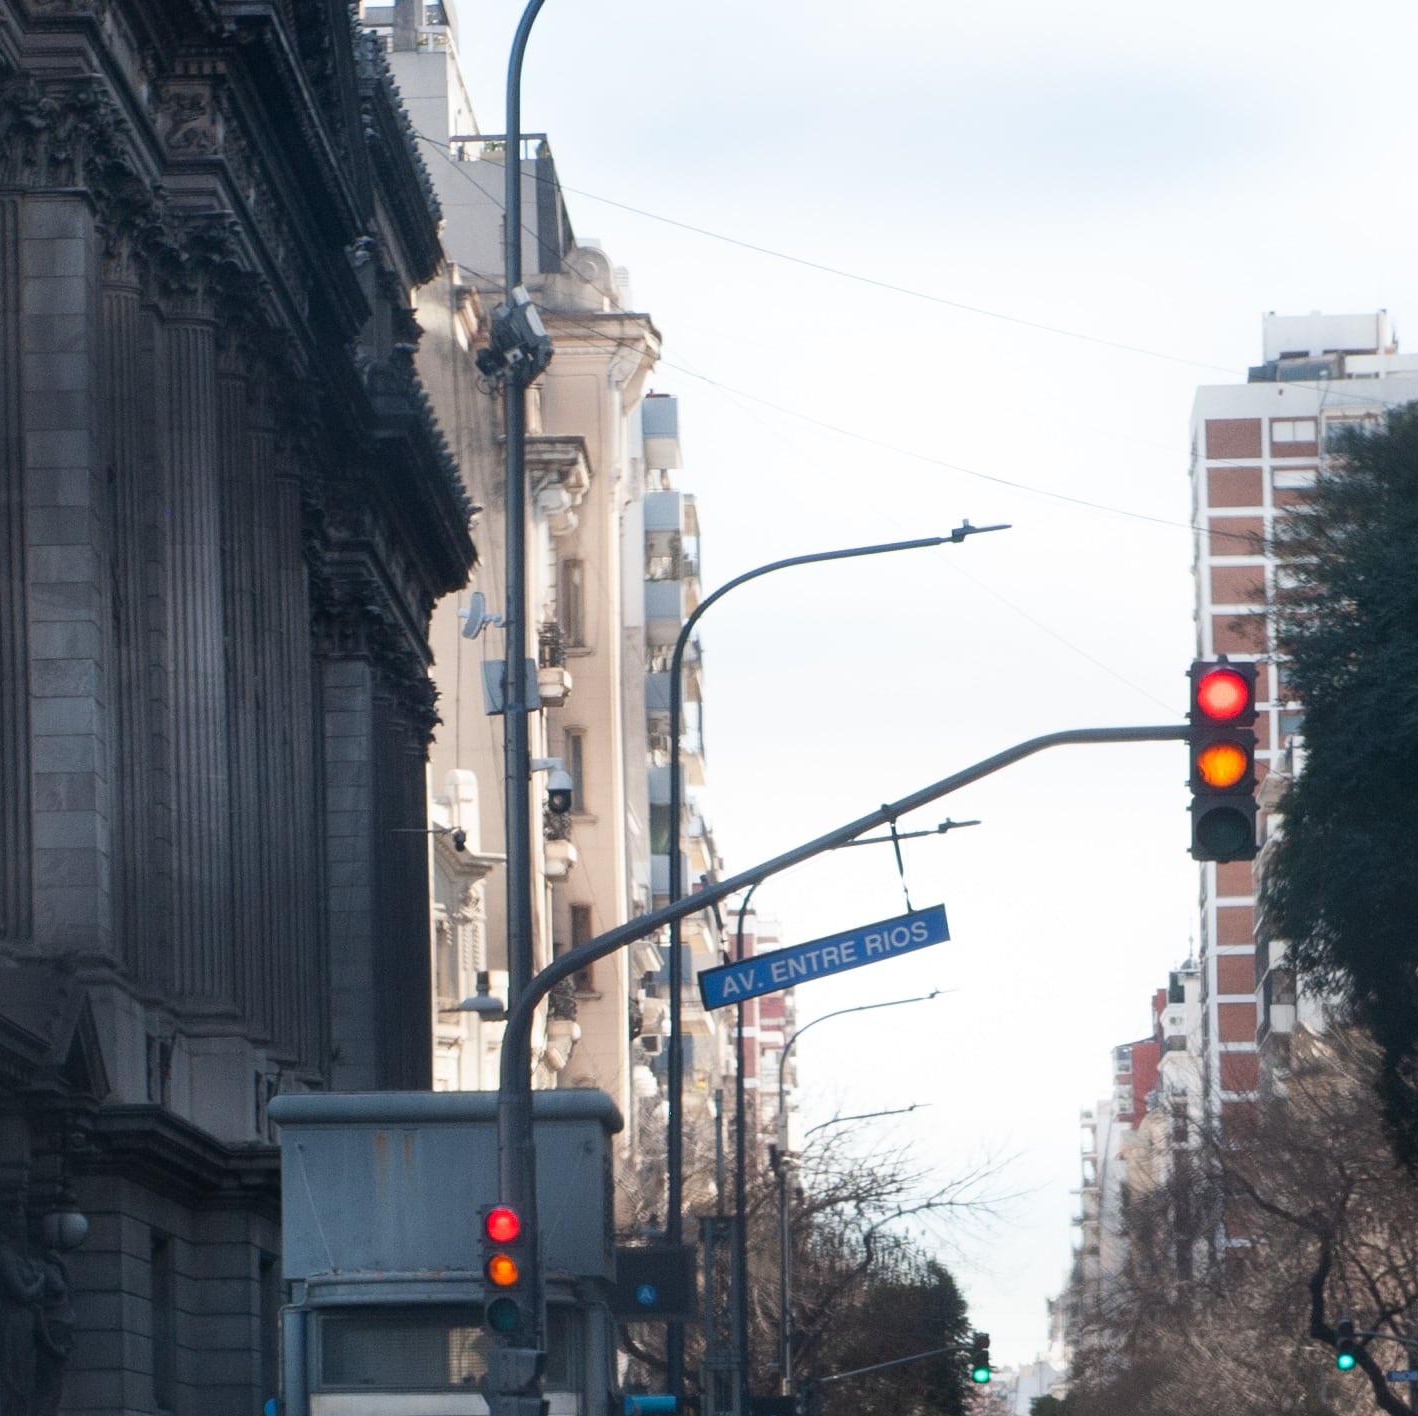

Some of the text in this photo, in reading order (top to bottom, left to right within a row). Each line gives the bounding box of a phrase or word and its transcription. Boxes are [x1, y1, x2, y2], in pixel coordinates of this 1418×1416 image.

[722, 921, 928, 998] AV. ENTRE RIOS
